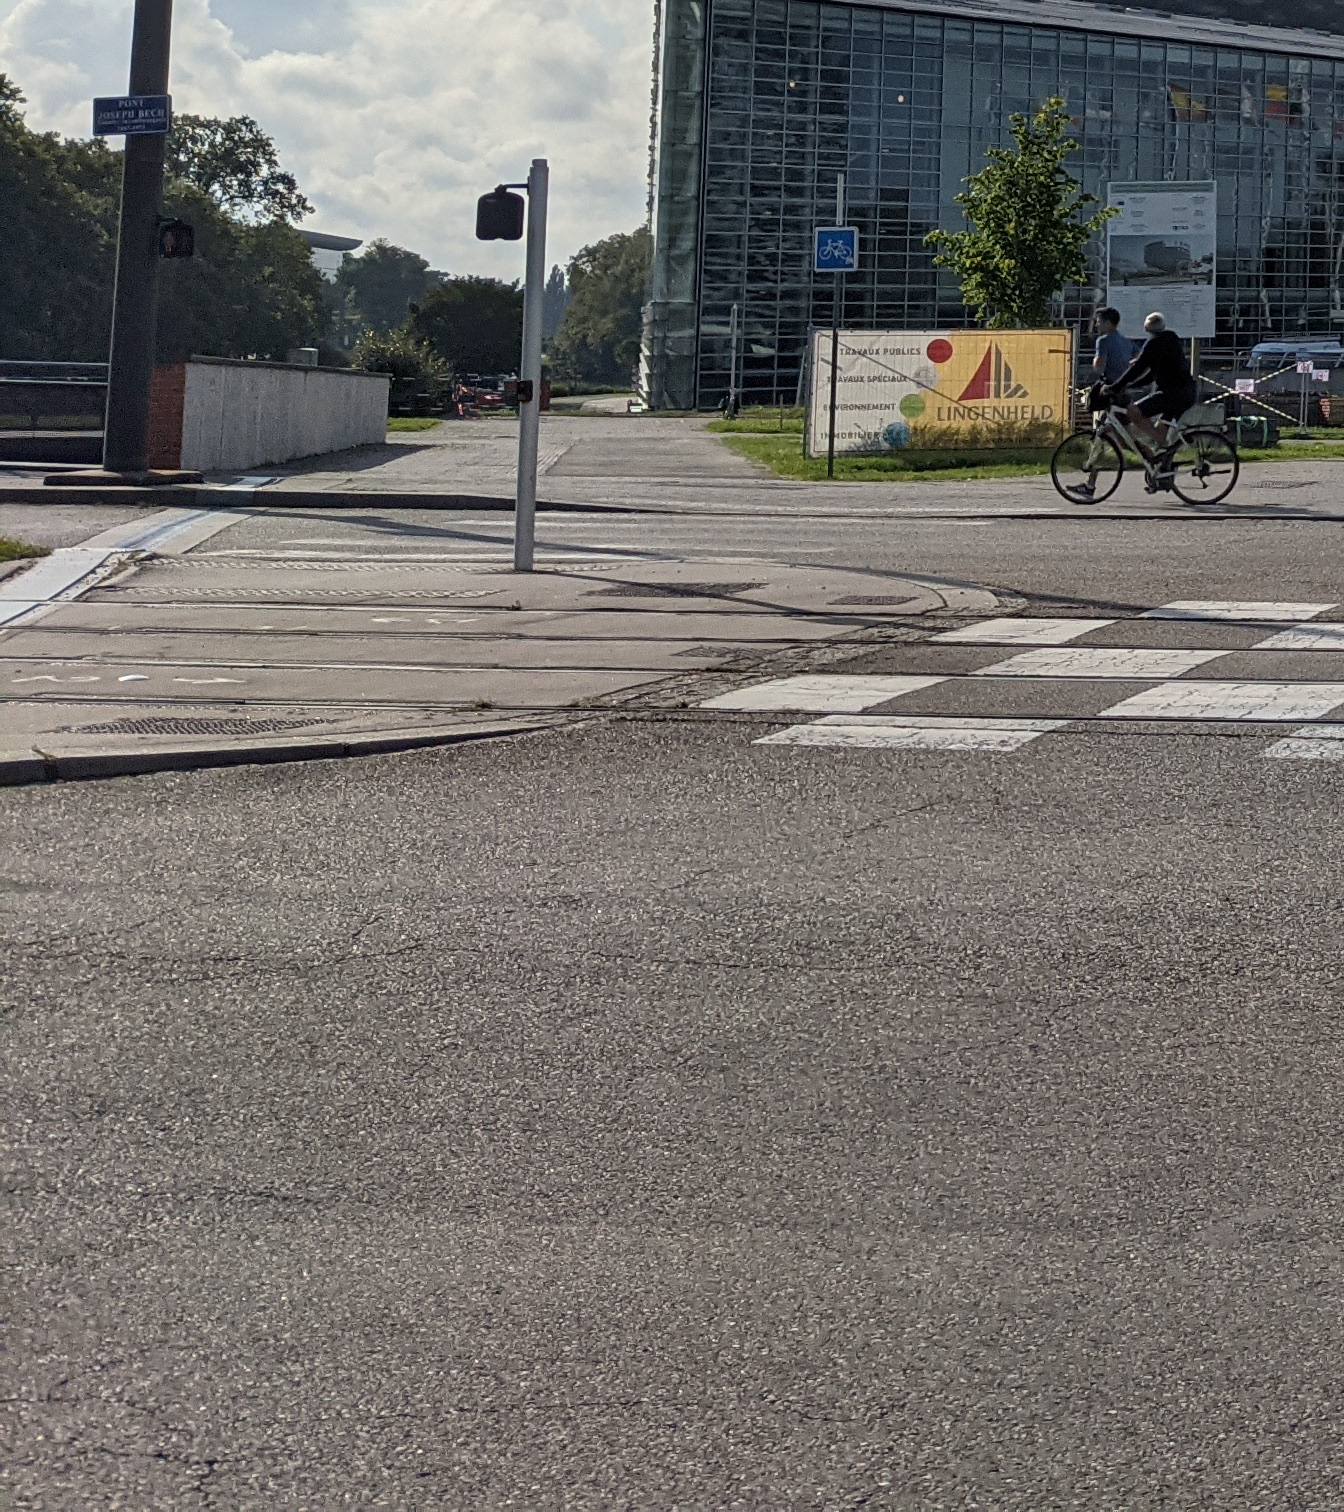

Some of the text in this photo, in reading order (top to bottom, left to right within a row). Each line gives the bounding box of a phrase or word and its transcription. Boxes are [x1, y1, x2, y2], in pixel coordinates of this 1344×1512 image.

[119, 99, 144, 108] PONT
[98, 108, 166, 120] JOSEPH BECH
[839, 348, 922, 356] TRAVAUX PUBLICS
[826, 375, 865, 383] TAVAUX
[823, 403, 897, 412] EVIRONNEMENT
[936, 404, 1054, 422] LINGENHELD
